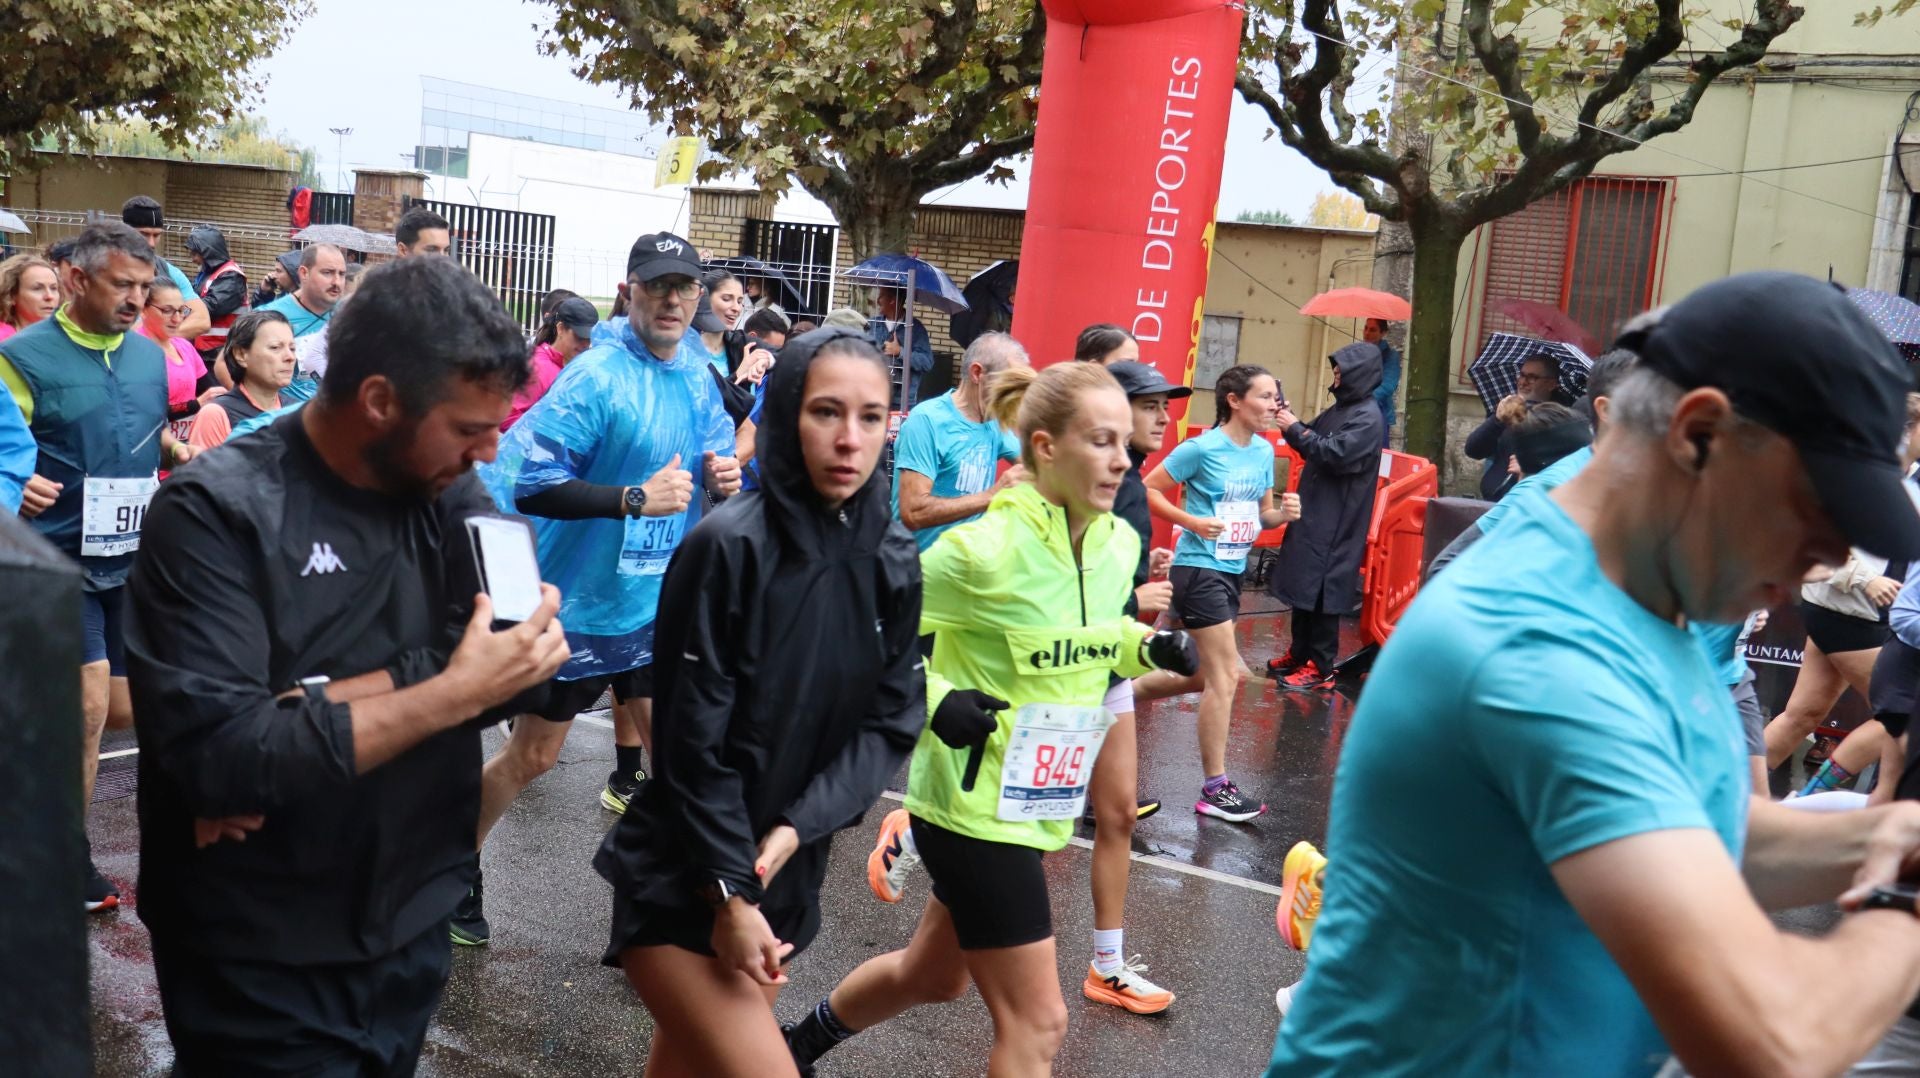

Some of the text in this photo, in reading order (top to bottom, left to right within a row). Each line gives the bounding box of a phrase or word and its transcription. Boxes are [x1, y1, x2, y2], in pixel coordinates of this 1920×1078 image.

[1132, 56, 1201, 342] DE DEPORTES
[116, 504, 146, 533] 911
[1231, 521, 1254, 542] 820
[642, 519, 675, 550] 374
[1032, 744, 1086, 787] 849
